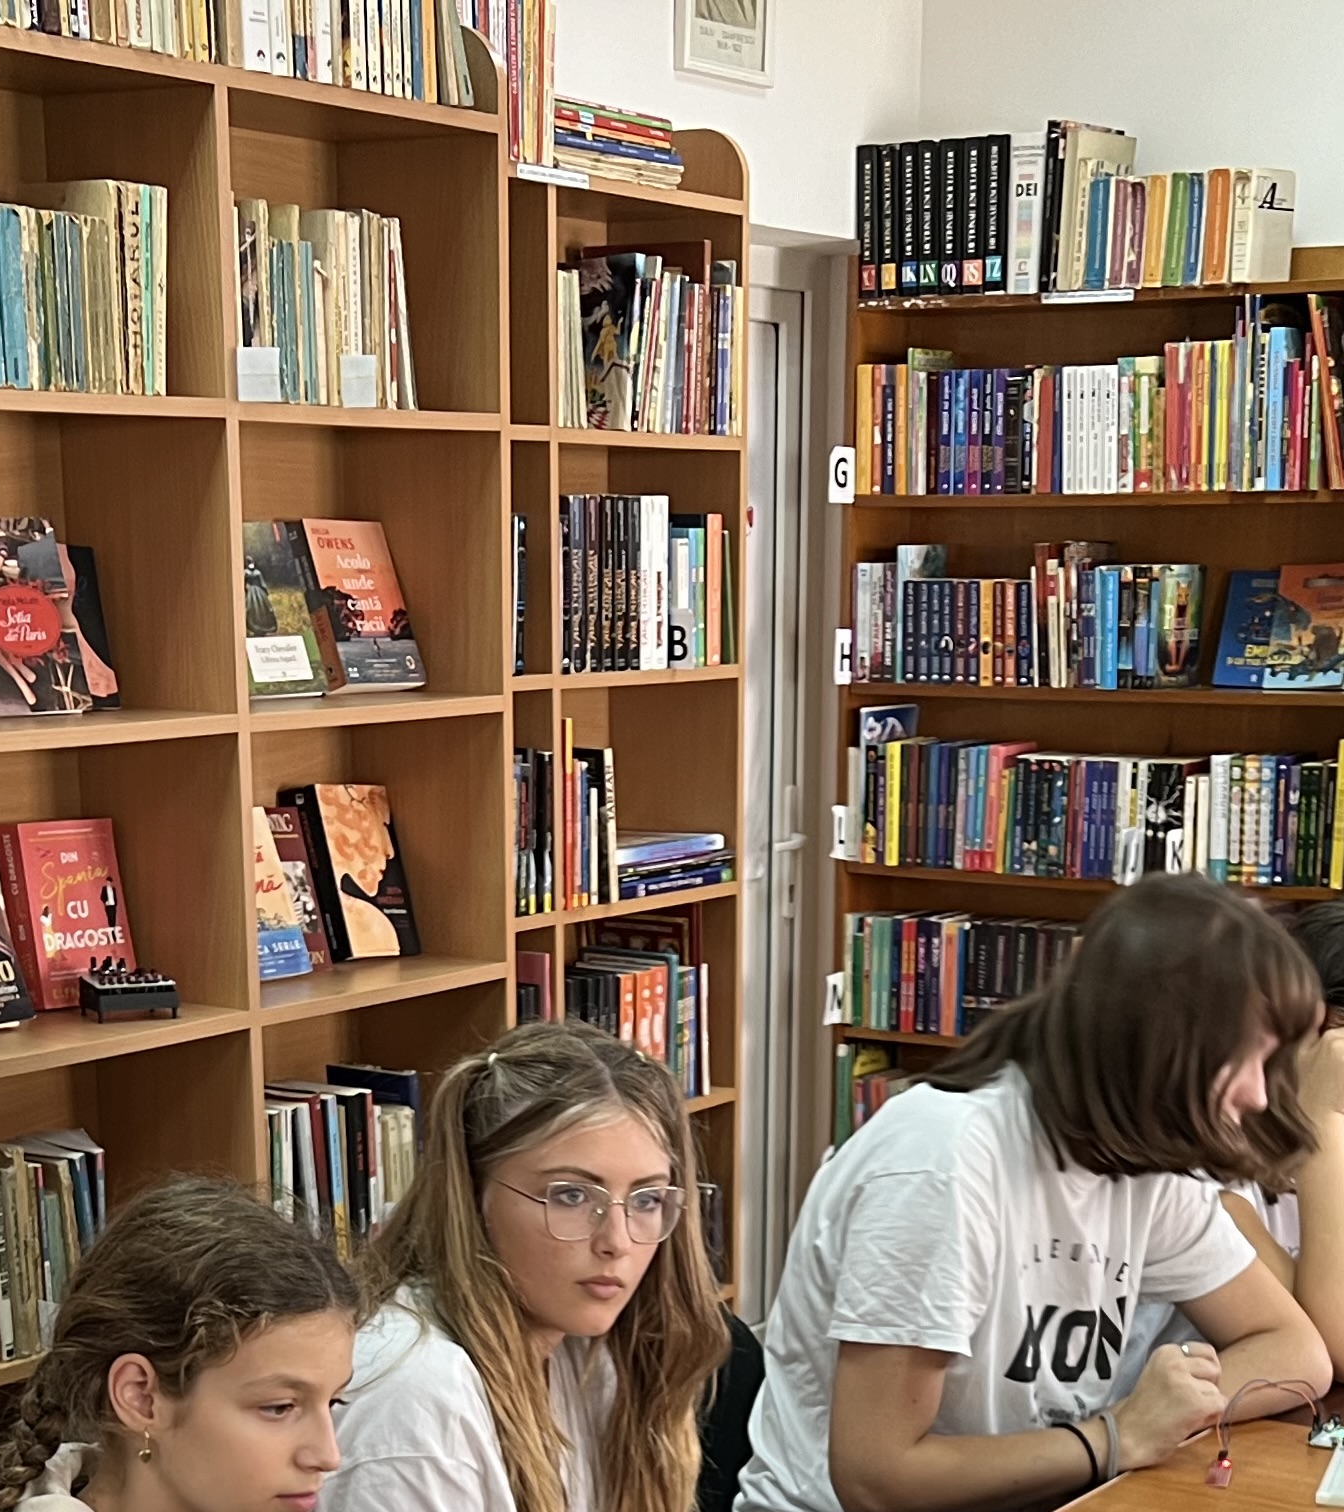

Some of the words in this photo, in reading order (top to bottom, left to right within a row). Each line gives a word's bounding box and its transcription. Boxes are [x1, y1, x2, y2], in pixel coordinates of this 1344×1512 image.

[1015, 183, 1038, 197] DEI
[834, 456, 849, 488] G
[317, 537, 355, 550] OWENS
[335, 554, 371, 570] Acolo
[342, 574, 375, 591] unde
[669, 626, 688, 660] B
[60, 851, 79, 864] DIN
[66, 900, 90, 919] CU
[44, 926, 125, 952] DRAGOSTE
